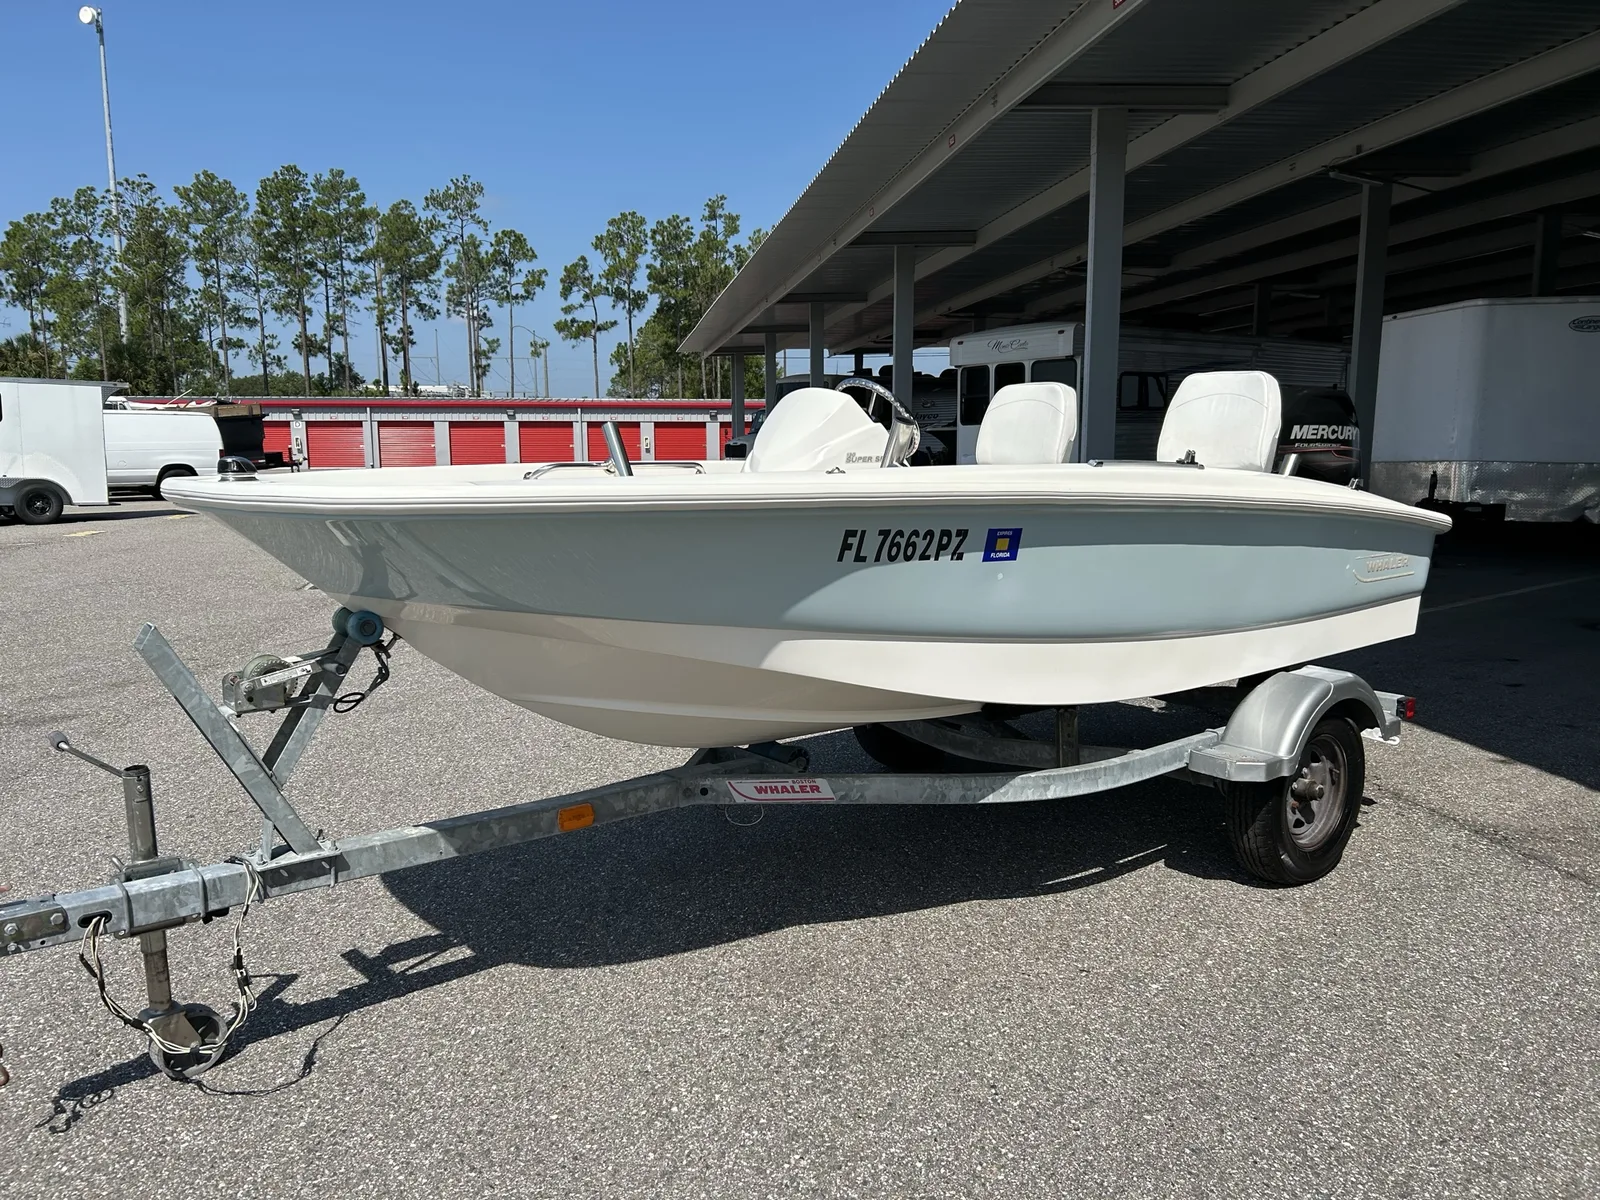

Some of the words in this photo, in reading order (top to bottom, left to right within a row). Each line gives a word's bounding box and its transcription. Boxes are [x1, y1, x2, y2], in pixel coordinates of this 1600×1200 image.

[1290, 425, 1359, 440] MERCURY
[845, 455, 873, 464] SUPER
[837, 529, 868, 562] FL
[1366, 556, 1409, 573] WHALER
[753, 785, 822, 794] WHALER
